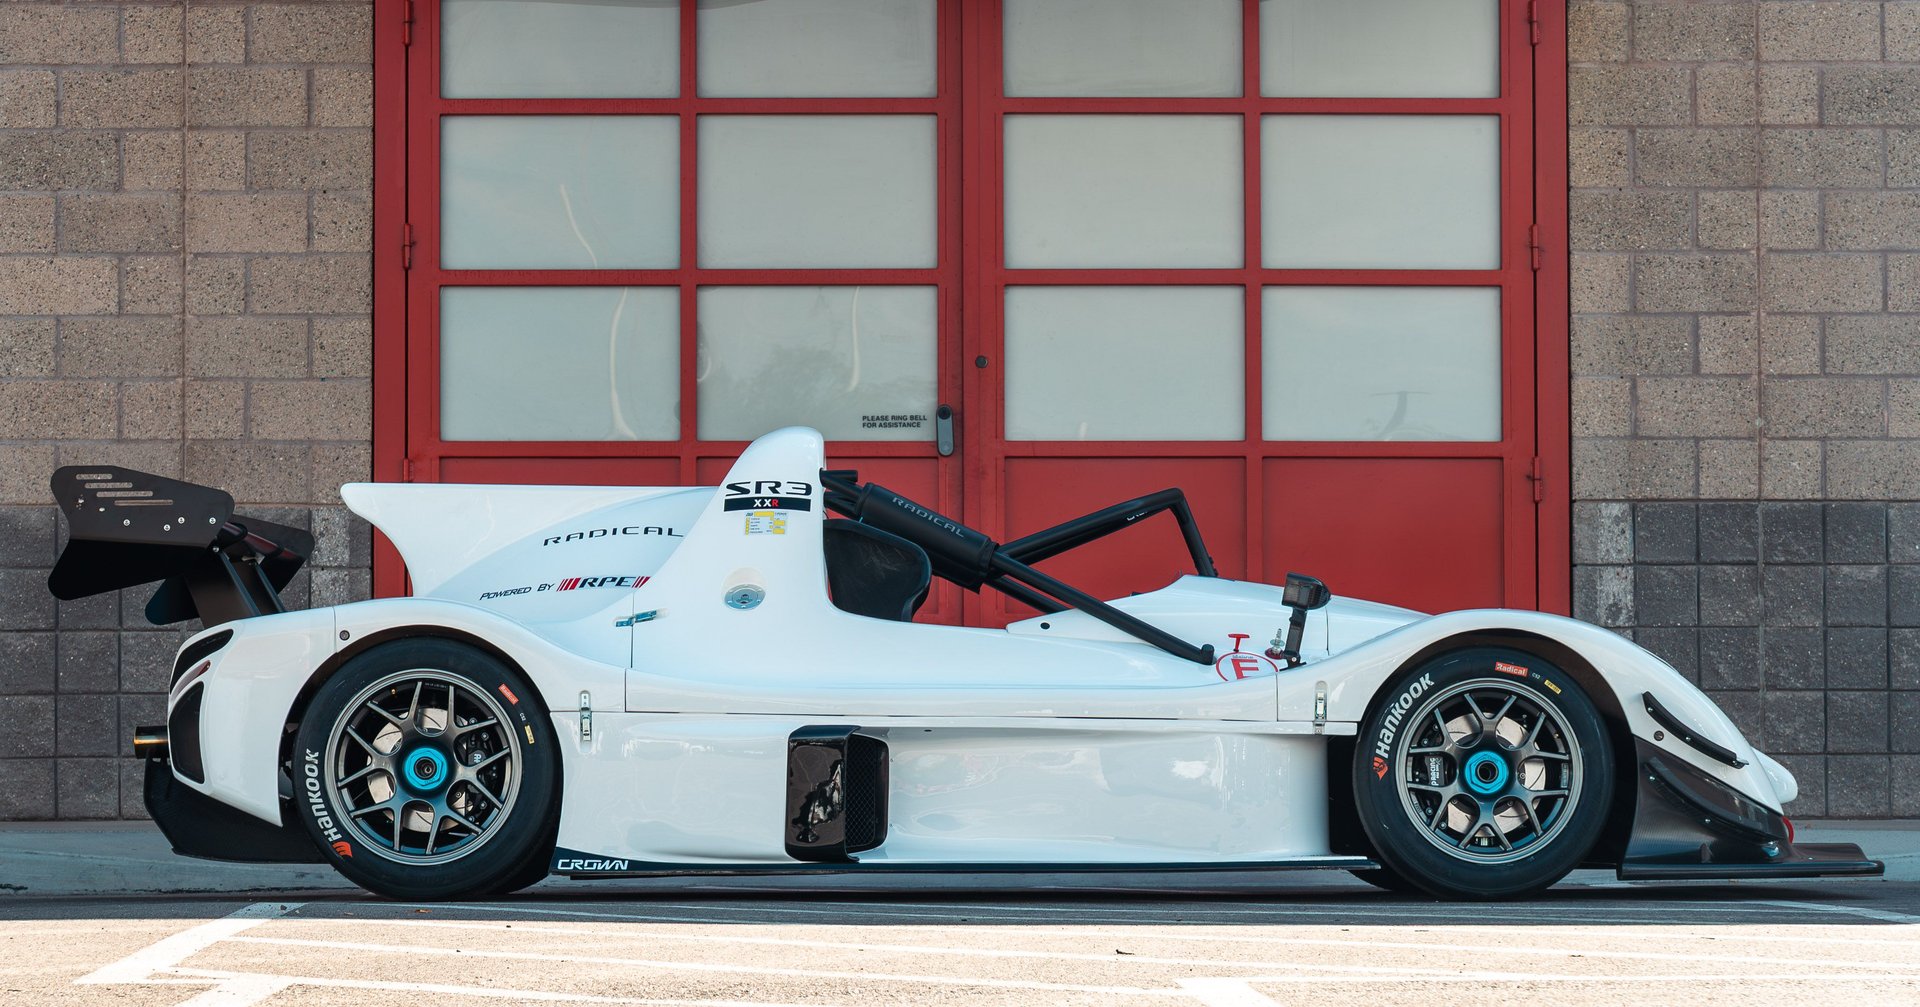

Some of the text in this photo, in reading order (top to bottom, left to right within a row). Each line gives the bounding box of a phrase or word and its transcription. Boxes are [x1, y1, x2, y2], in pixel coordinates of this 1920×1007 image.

[725, 480, 813, 497] SR3
[753, 498, 779, 508] XXR
[891, 496, 965, 539] RADICAL
[543, 526, 684, 546] RADICAL
[479, 586, 532, 601] POWERED
[578, 576, 637, 589] RPE
[1496, 663, 1527, 676] Radical
[557, 859, 629, 871] CROWN
